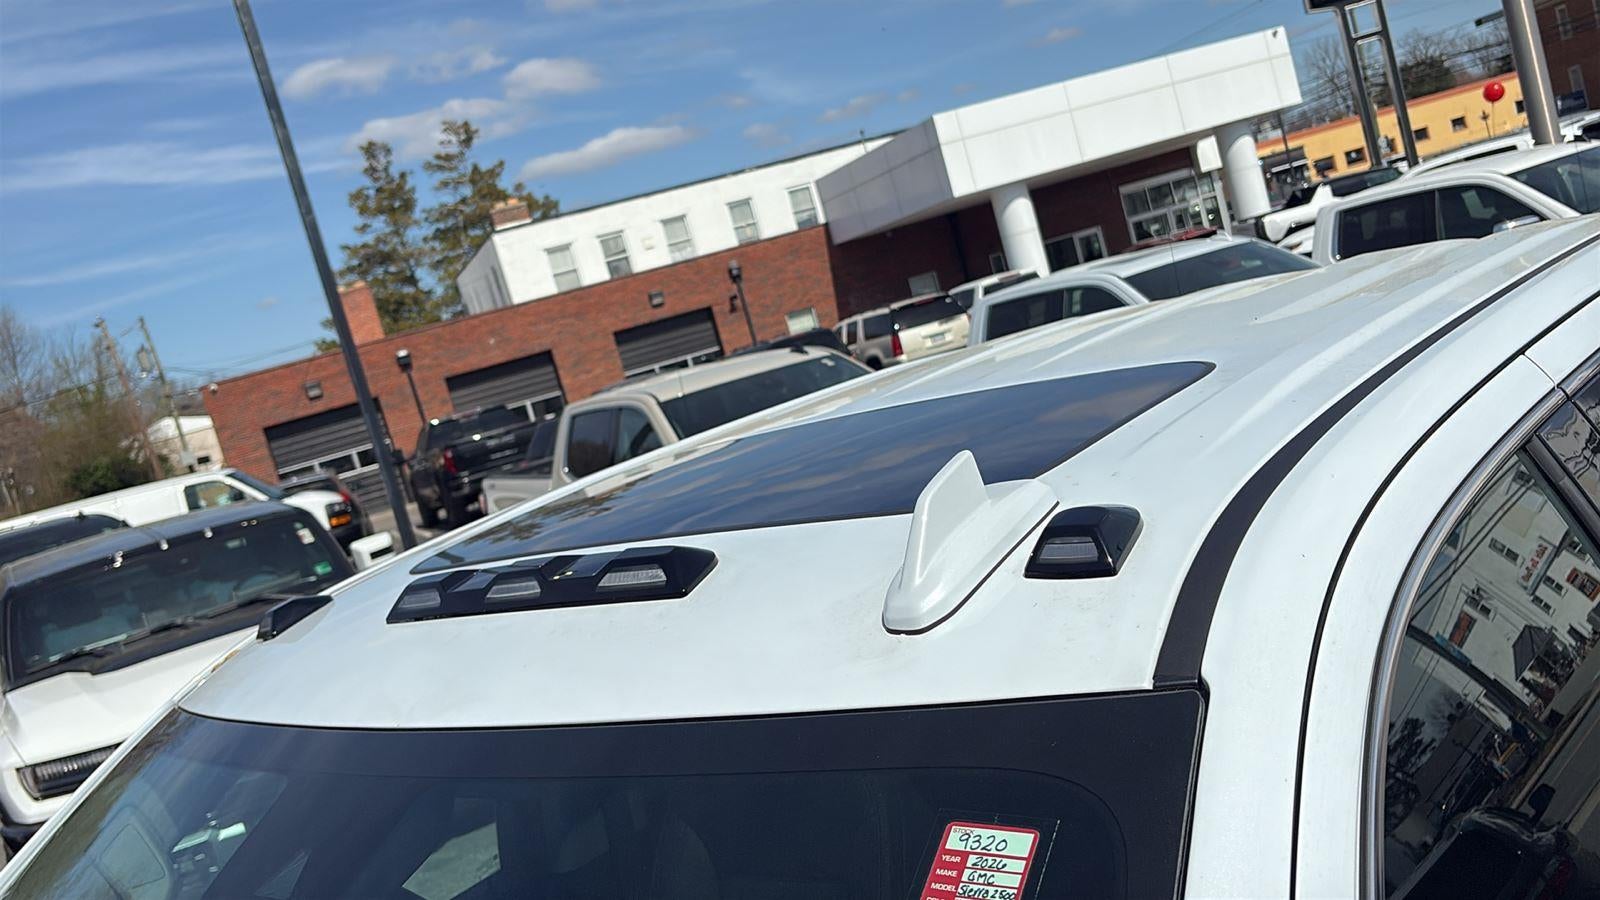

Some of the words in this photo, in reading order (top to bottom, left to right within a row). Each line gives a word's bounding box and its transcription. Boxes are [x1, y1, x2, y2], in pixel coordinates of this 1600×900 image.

[953, 827, 975, 835] STOCK
[959, 833, 1008, 852] 9320
[942, 855, 961, 863] YEAR
[971, 857, 1007, 870] 2026
[935, 868, 958, 878] MAKE
[967, 871, 995, 885] GMC
[930, 882, 957, 892] MODEL
[957, 884, 990, 897] Sierra
[990, 889, 1016, 900] 2500
